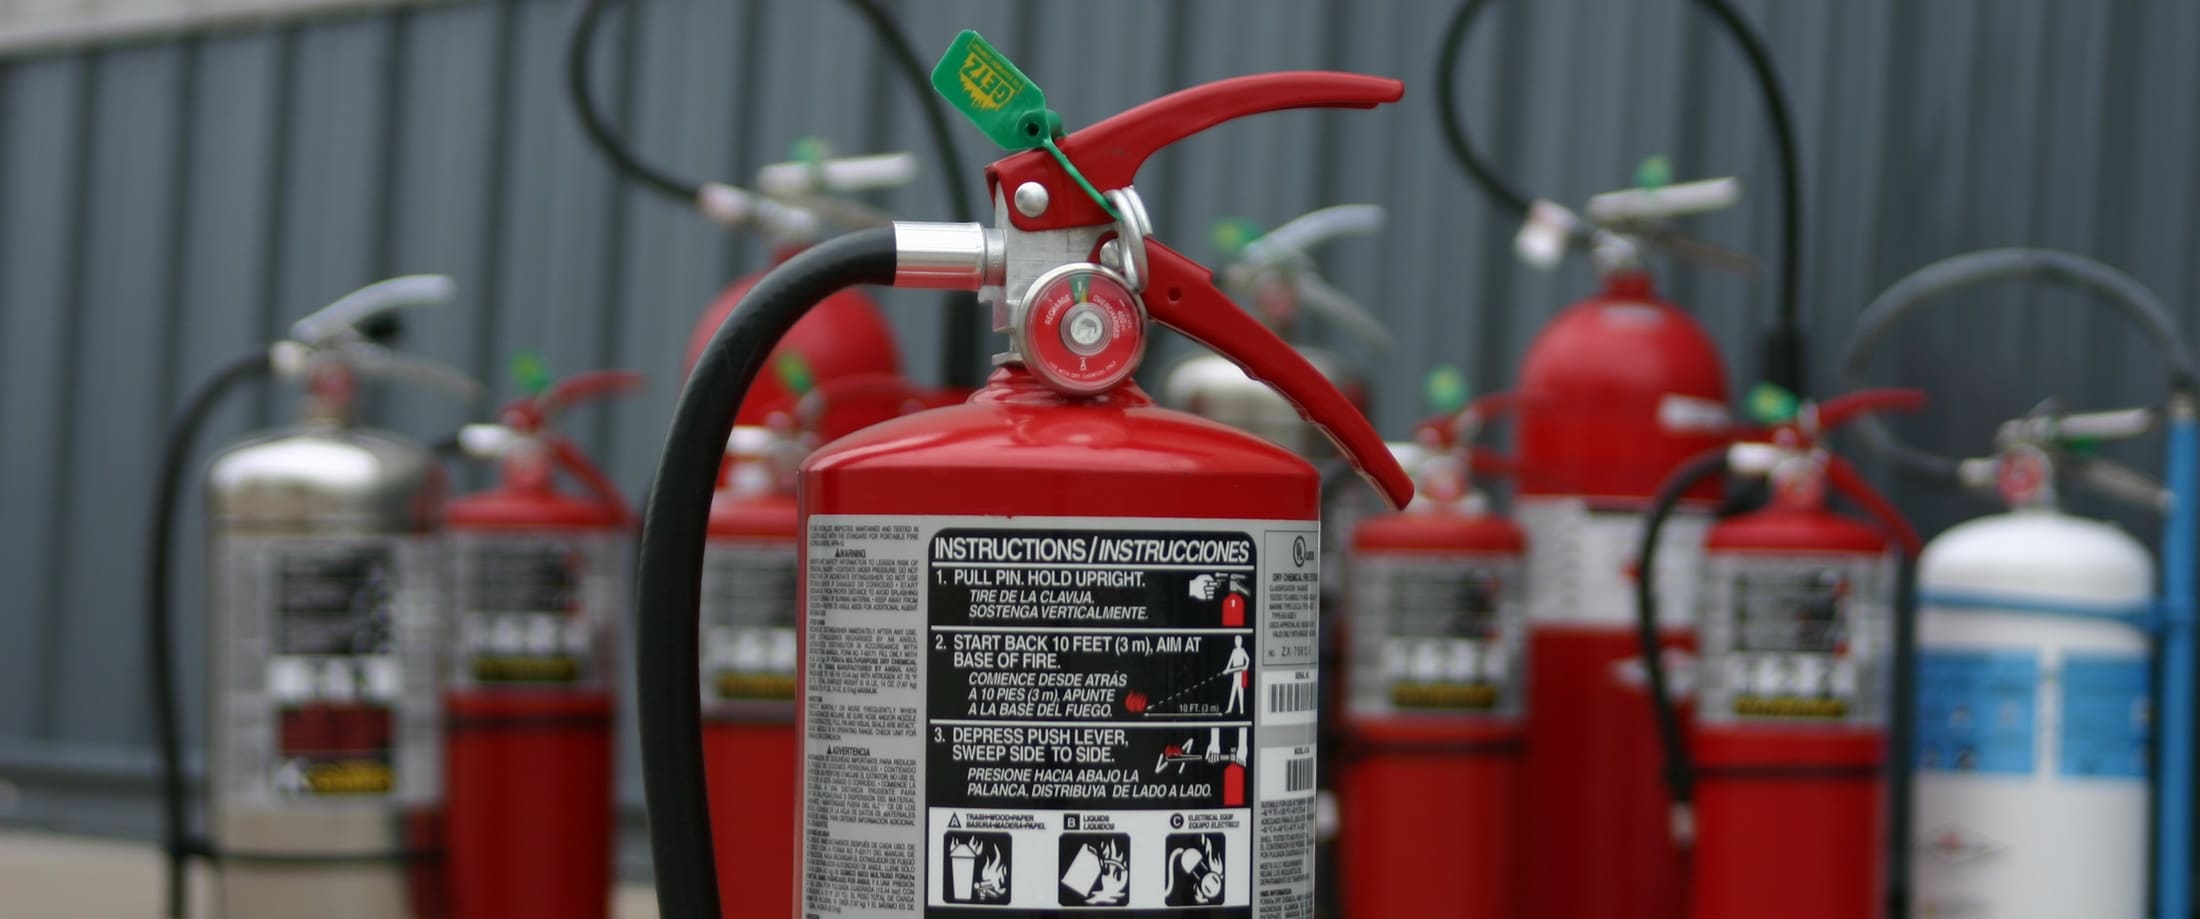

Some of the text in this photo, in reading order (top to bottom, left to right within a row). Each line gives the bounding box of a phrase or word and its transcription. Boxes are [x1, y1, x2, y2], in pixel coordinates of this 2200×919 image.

[961, 60, 1011, 104] GETZ
[936, 569, 1146, 587] 1. PULL PIN. HOLD UPRIGHT.
[970, 589, 1095, 604] TIRE DE LA CLAVIJA.
[969, 604, 1149, 619] SOSTENGA VERTICALMENTE.
[935, 634, 947, 650] 2.
[954, 634, 1001, 650] START
[1005, 635, 1048, 651] BACK
[1053, 636, 1069, 652] 10
[1073, 636, 1112, 652] FEET
[1115, 636, 1129, 656] (3
[1156, 637, 1182, 652] AIM
[1186, 637, 1202, 652] AT
[954, 652, 1061, 669] BASE OF FIRE.
[969, 670, 1127, 687] COMIENCE DESDE ATRÁS
[968, 687, 977, 700] A
[981, 687, 994, 700] 10
[997, 688, 1026, 701] PIES
[1028, 688, 1040, 704] (3
[1063, 689, 1116, 702] APUNTE
[968, 702, 1112, 717] A LA BASE DEL FUEGO.
[1179, 704, 1188, 712] 10
[1189, 704, 1200, 712] FT.
[934, 726, 1129, 748] 3. DEPRESS PUSH LEVER,
[952, 745, 1115, 763] SWEEP SIDE TO SIDE.
[967, 768, 1139, 783] PRESIONE HACIA ABAJO LA
[967, 783, 1212, 798] PALANCA, DISTRIBUYA DE LADO A LADO.
